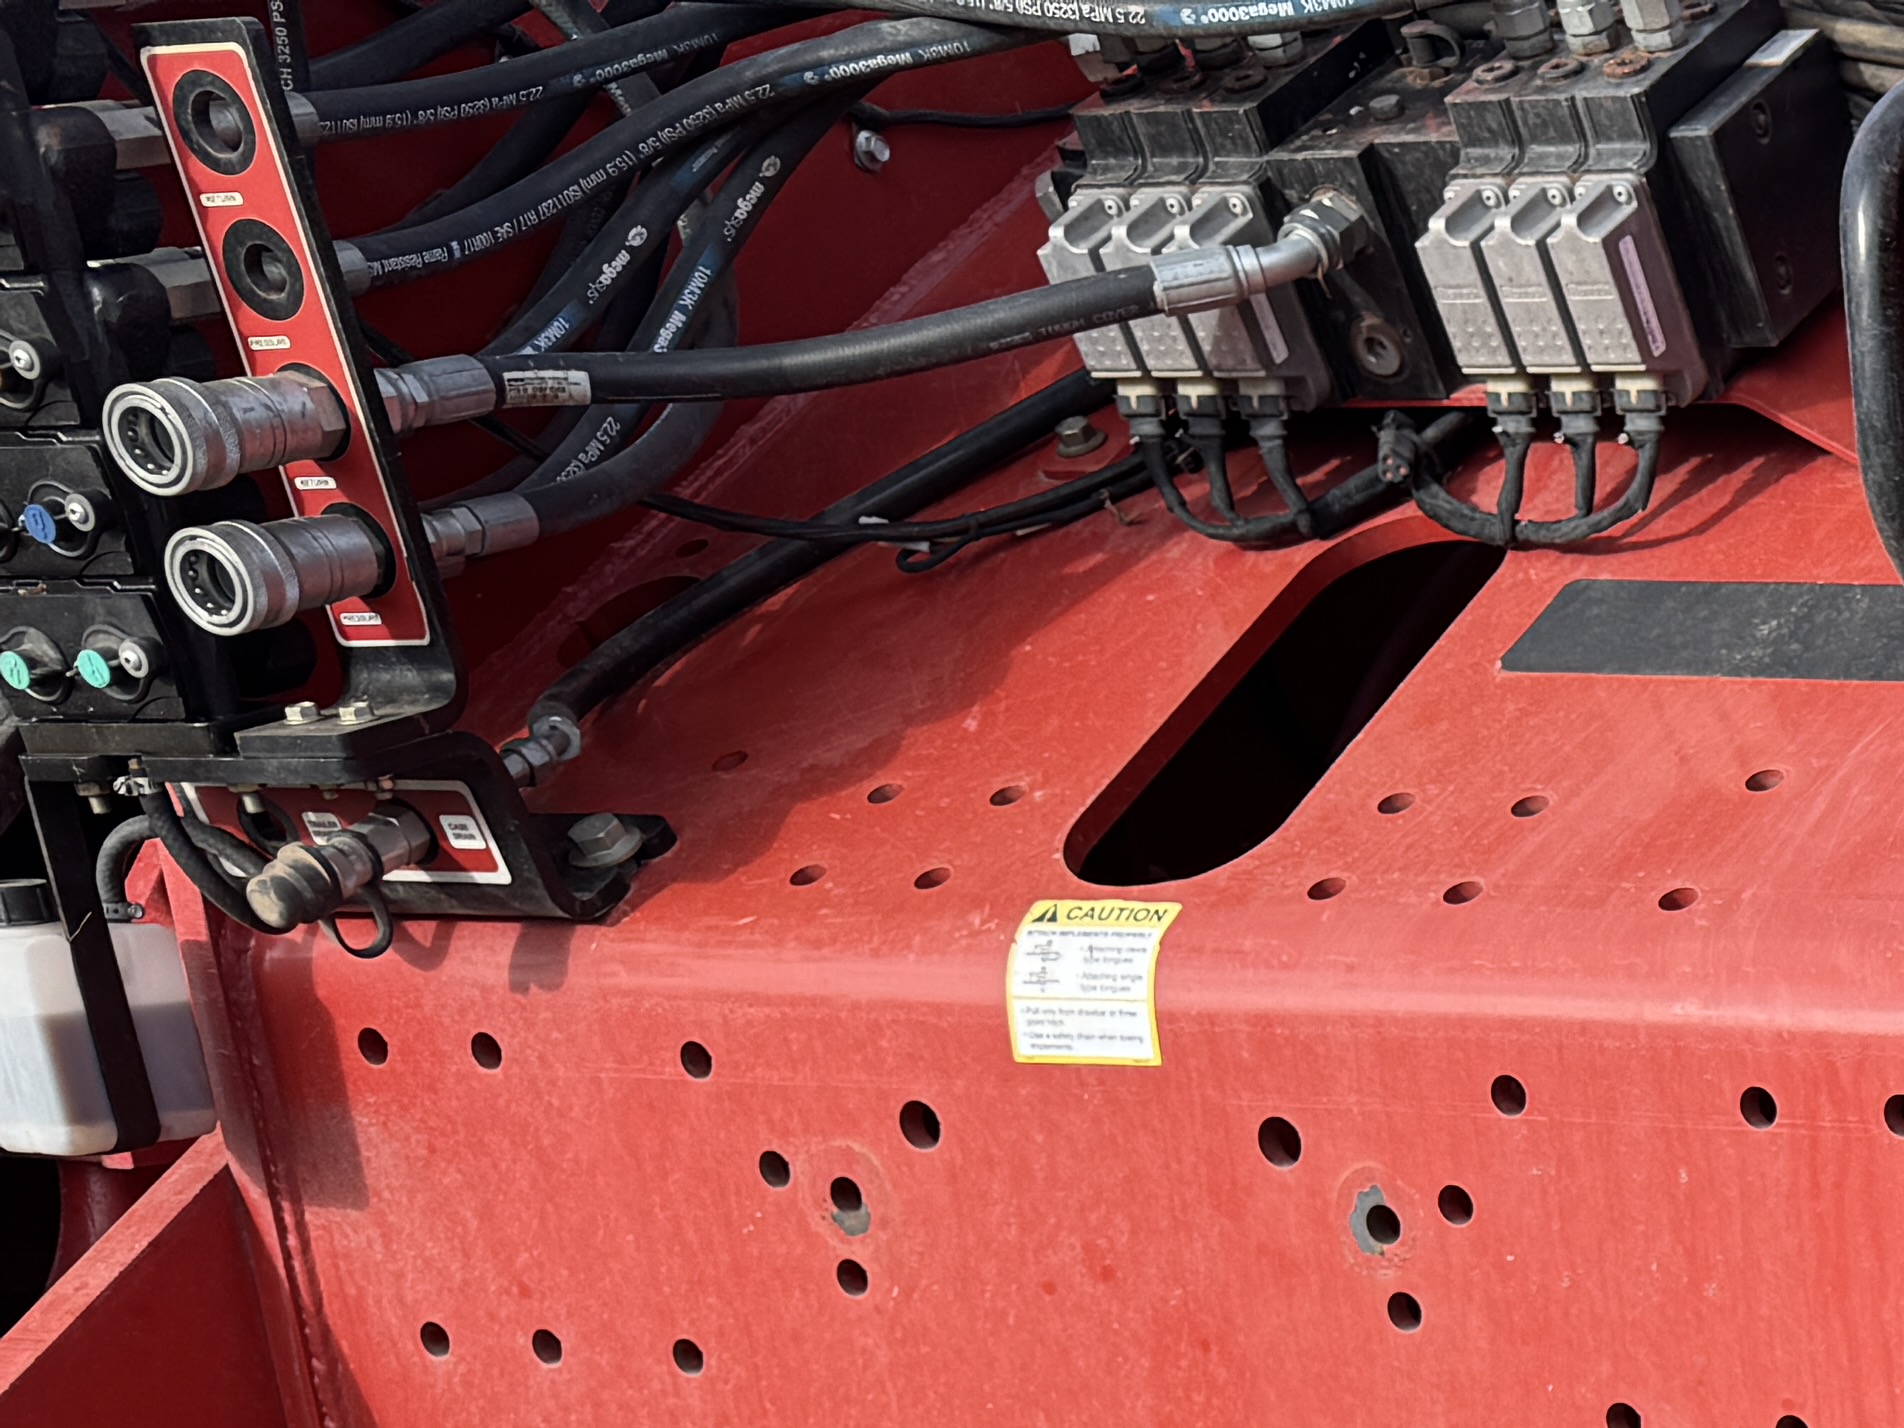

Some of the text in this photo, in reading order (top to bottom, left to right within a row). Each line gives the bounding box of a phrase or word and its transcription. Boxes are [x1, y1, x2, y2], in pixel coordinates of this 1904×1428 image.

[270, 0, 286, 22] PS
[274, 27, 291, 63] 3250
[1066, 906, 1168, 922] CAUTION
